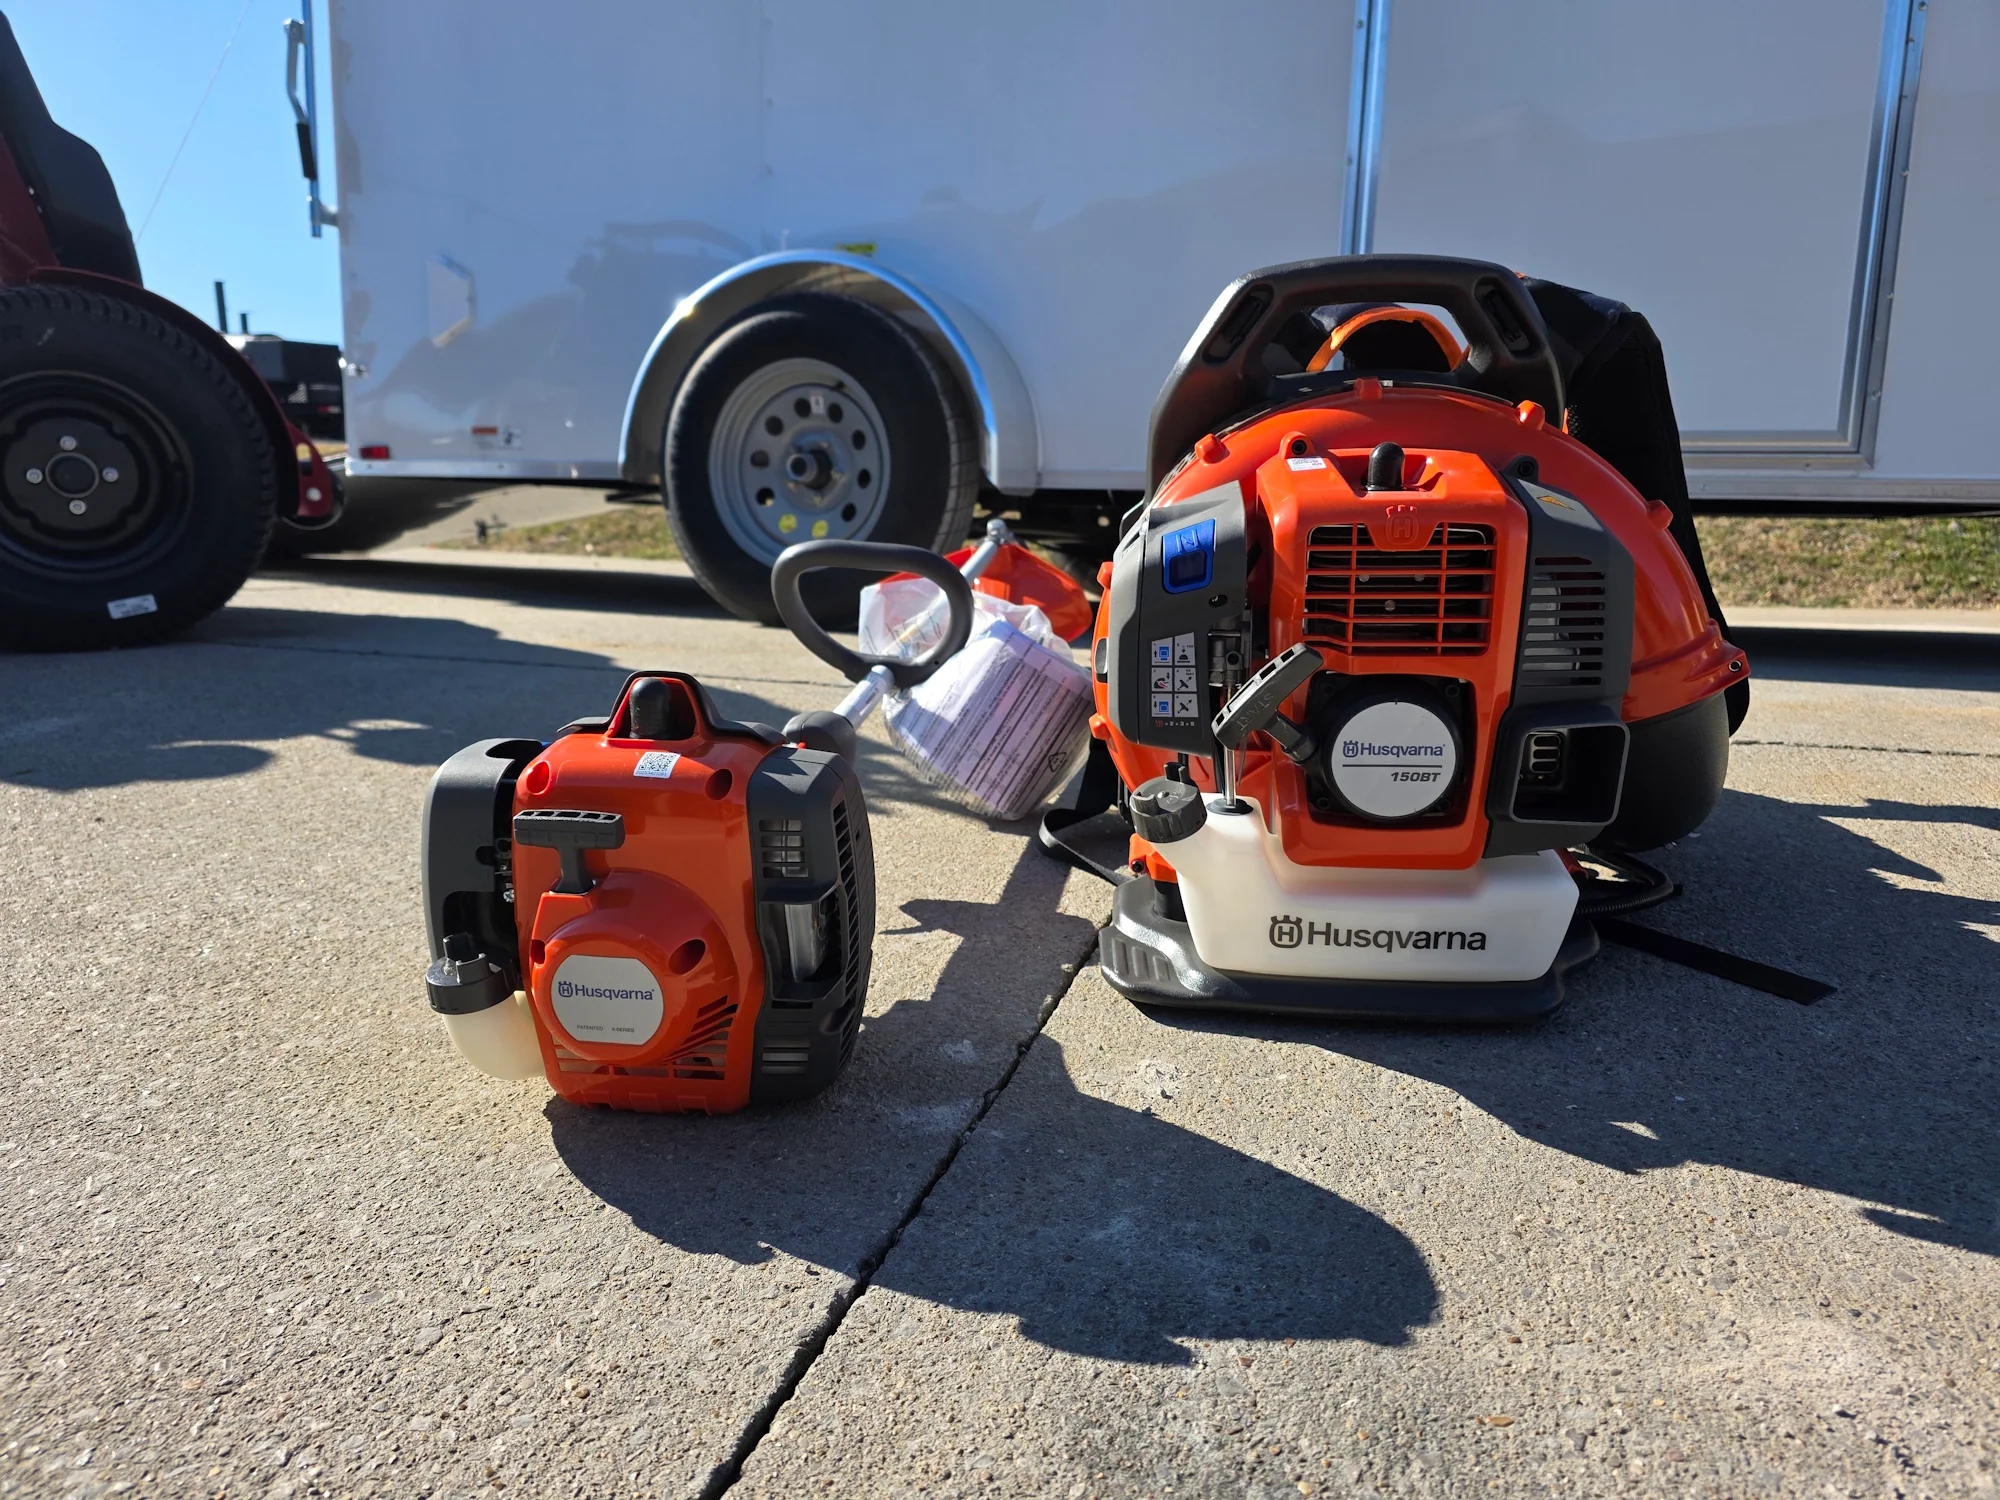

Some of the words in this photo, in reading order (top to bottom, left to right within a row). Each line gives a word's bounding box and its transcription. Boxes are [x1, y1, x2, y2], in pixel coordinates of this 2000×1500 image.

[1236, 691, 1275, 732] START
[1360, 742, 1443, 758] Husqvarna
[1390, 772, 1441, 782] 150BT
[1307, 921, 1487, 953] Husqvarna
[574, 984, 653, 1001] Husqvarna
